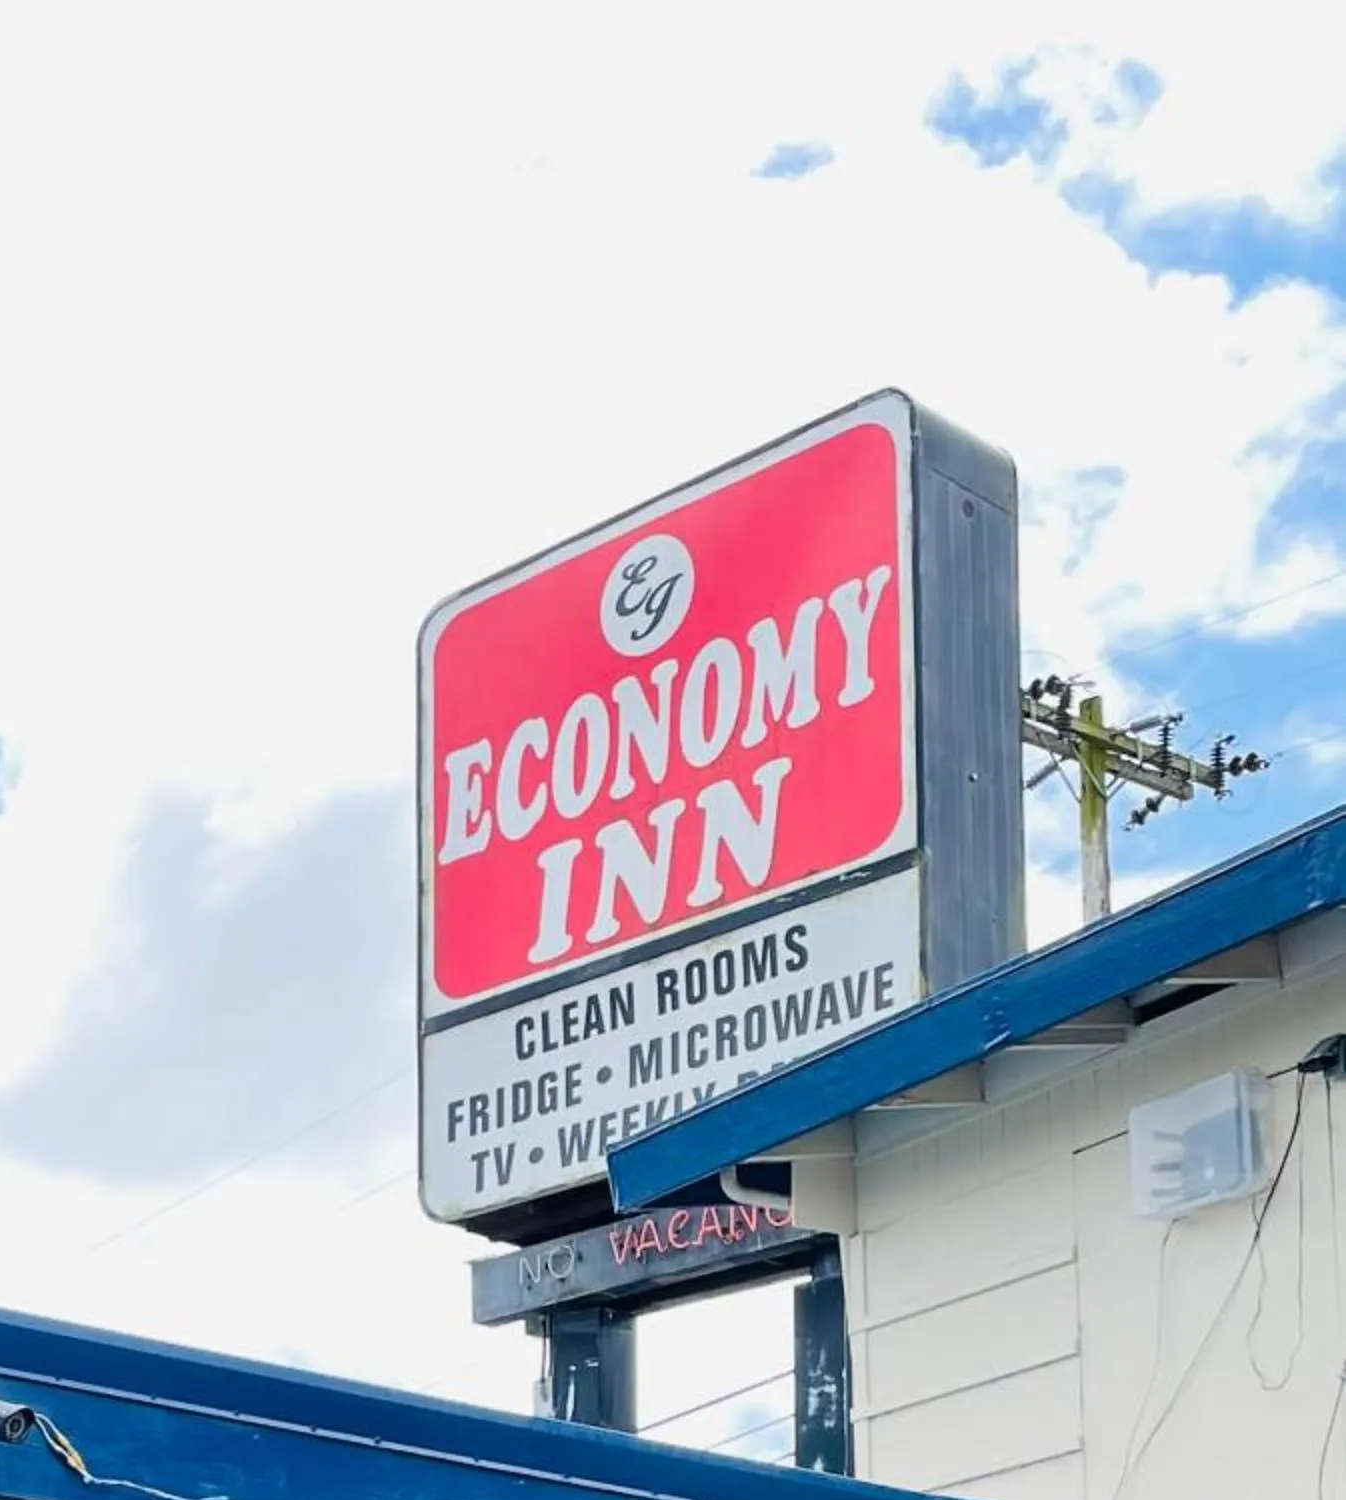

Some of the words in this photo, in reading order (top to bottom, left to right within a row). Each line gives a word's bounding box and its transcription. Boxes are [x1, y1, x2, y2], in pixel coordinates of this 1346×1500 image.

[438, 564, 892, 865] ECONOMY
[527, 757, 793, 963] INN
[446, 1062, 583, 1143] FRIDGE
[628, 961, 895, 1088] MICROWAVE
[515, 981, 636, 1061] CLEAN
[656, 924, 810, 1015] ROOMS
[470, 1142, 517, 1193] TV
[518, 1240, 575, 1286] NO
